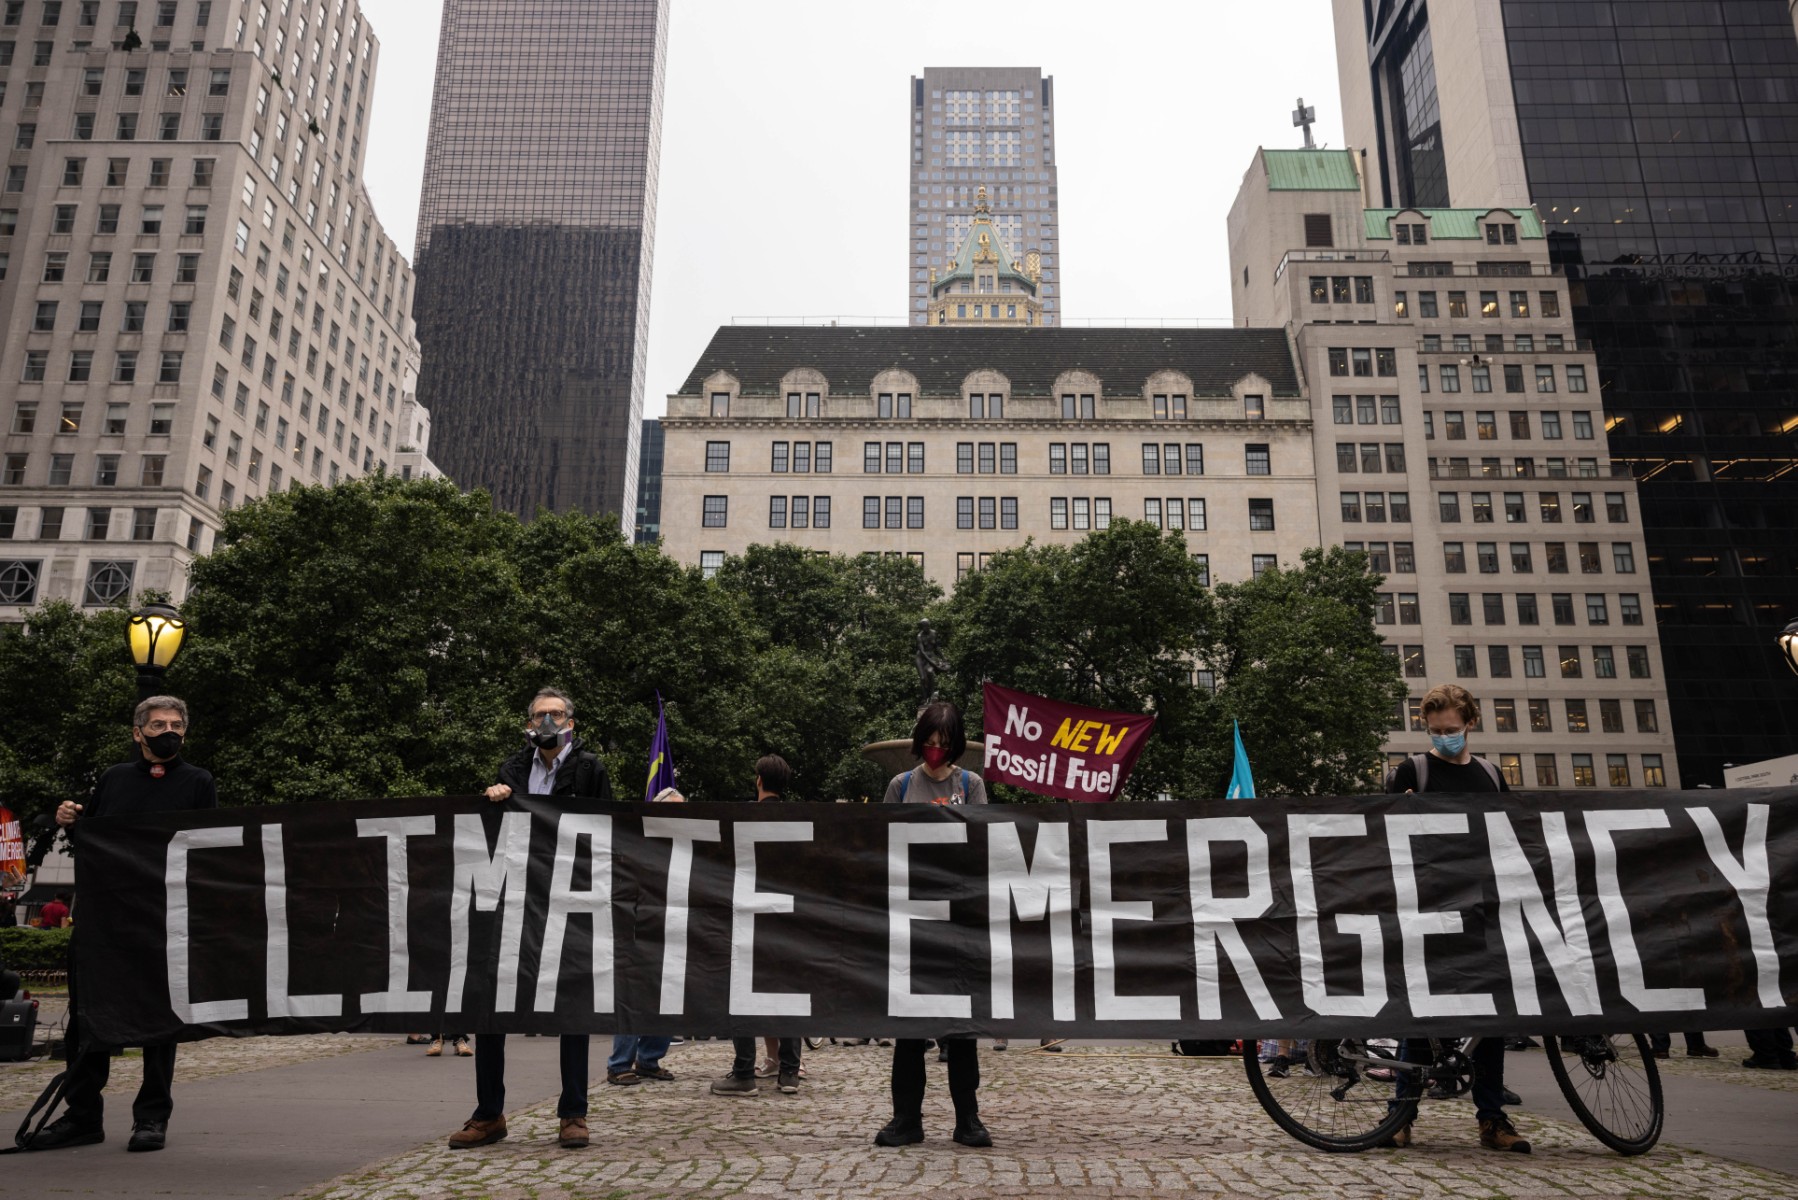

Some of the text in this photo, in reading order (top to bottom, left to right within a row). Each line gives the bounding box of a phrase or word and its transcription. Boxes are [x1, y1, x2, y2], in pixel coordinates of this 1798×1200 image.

[1004, 704, 1129, 756] No NEW
[984, 733, 1120, 795] Fossil Fuel
[165, 803, 1787, 1024] CLIMATE EMERGENCY
